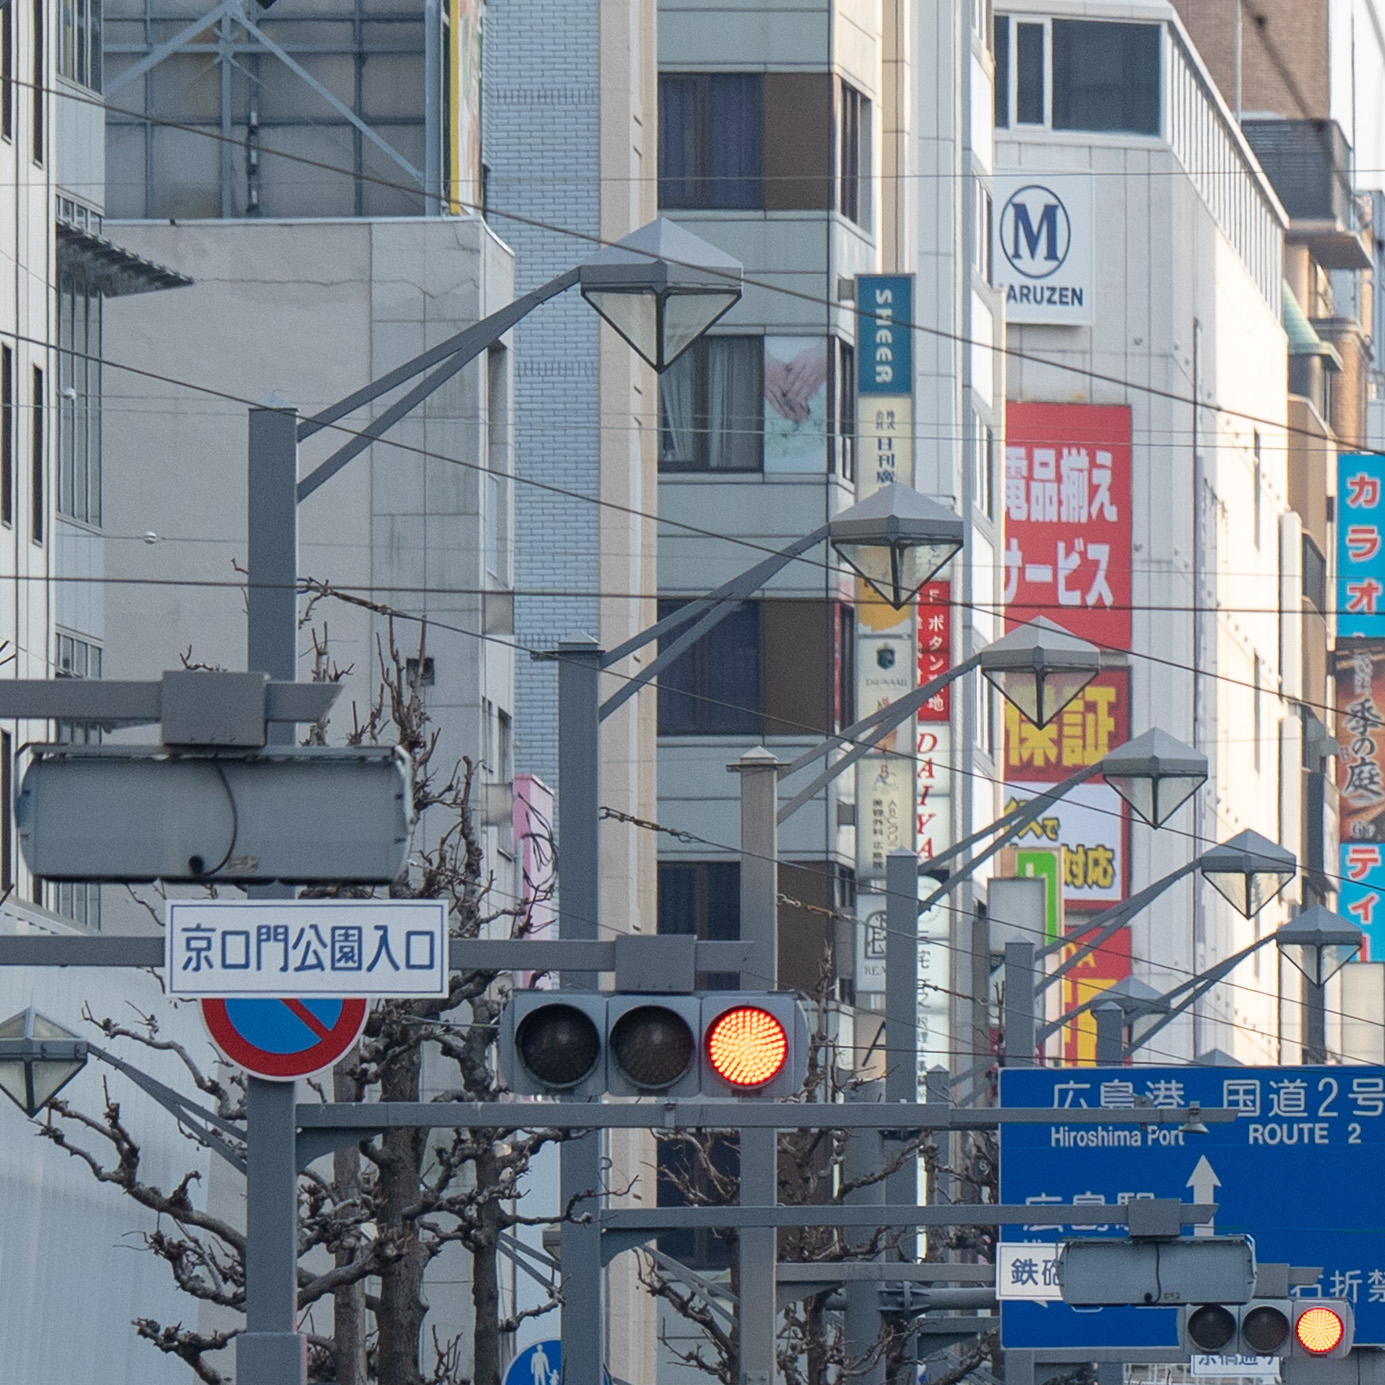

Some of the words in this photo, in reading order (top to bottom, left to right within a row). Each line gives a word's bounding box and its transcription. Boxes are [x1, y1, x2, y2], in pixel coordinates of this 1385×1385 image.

[1010, 202, 1060, 262] M
[1006, 284, 1084, 307] ARUZEN
[875, 436, 896, 490] 日刊廣
[1346, 472, 1382, 614] カラオ
[916, 732, 938, 860] DAIYA
[179, 922, 437, 974] 京口門公園入口
[1052, 1078, 1186, 1110] 広島港
[1050, 1126, 1142, 1148] Hiroshima
[1146, 1126, 1185, 1147] Port
[1248, 1123, 1329, 1145] ROUTE
[1348, 1123, 1362, 1145] 2
